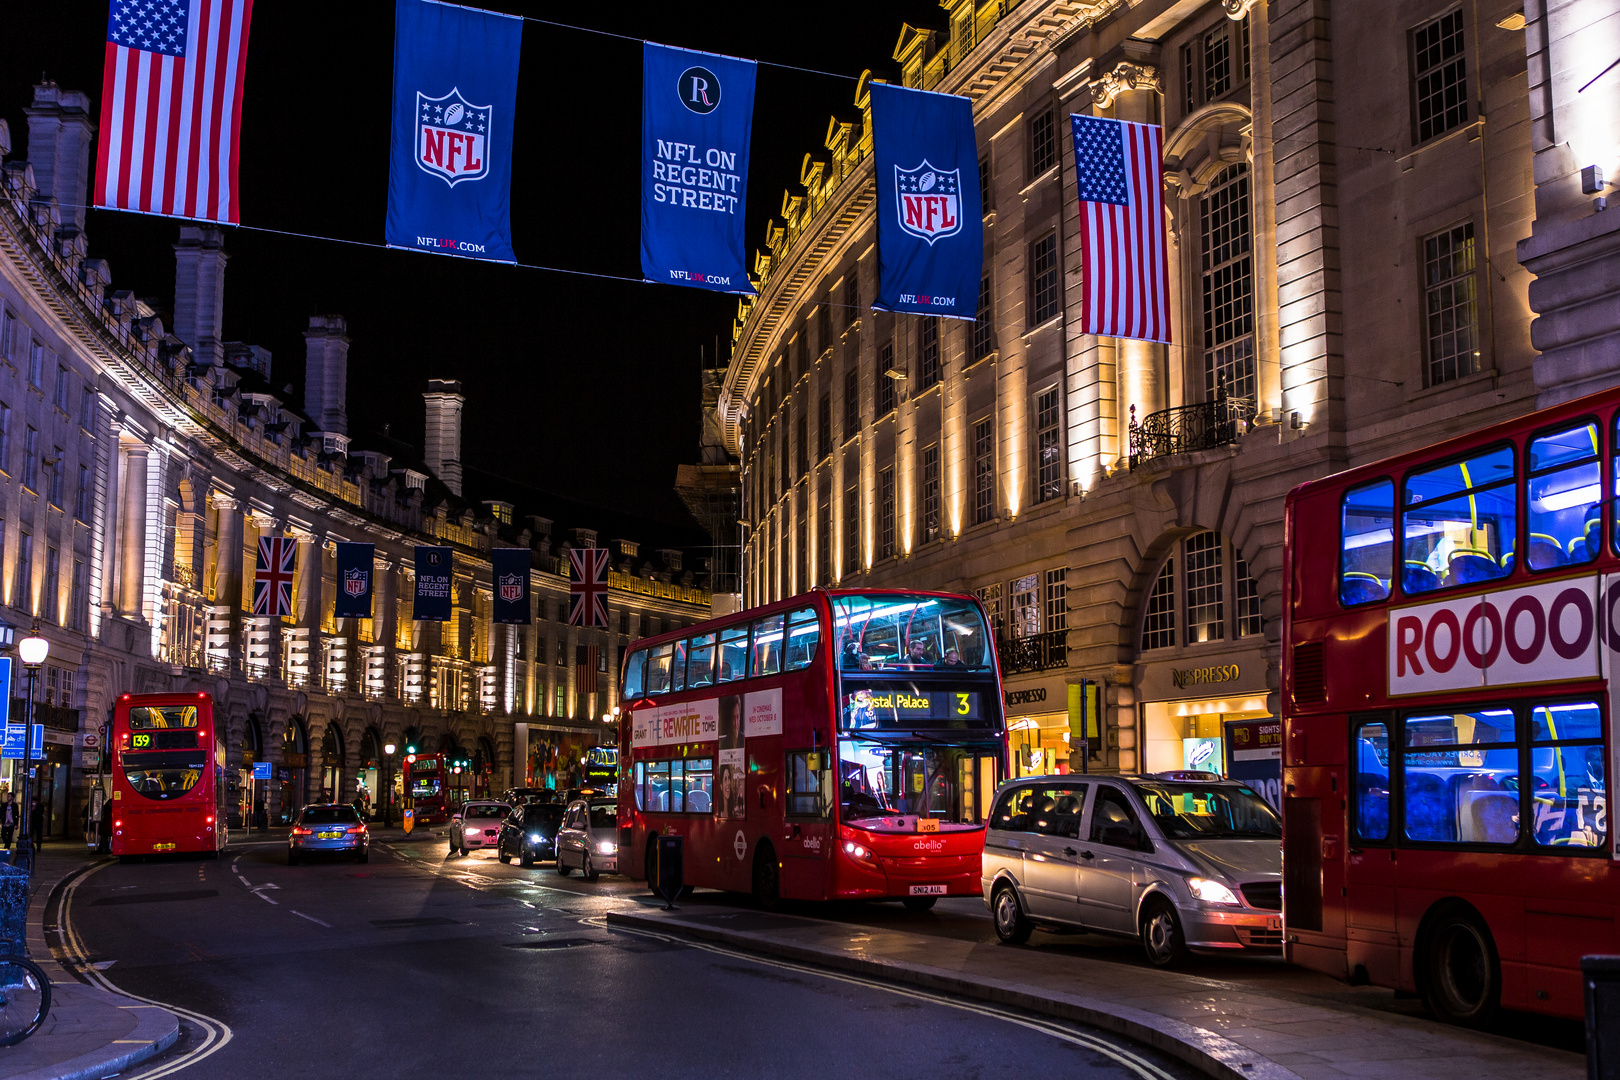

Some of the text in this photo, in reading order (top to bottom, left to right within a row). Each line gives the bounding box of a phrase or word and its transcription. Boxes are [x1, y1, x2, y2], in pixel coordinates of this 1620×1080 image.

[690, 76, 714, 106] R
[423, 127, 481, 174] NFL
[657, 139, 736, 170] NFL ON
[653, 159, 740, 193] REGENT
[654, 183, 738, 214] STREET
[904, 196, 955, 232] NFL
[417, 236, 485, 252] NFLUK.COM
[670, 270, 731, 285] NFLUK.COM
[899, 293, 956, 306] NFLUK.COM
[430, 553, 439, 563] R
[347, 580, 365, 592] NFL
[418, 582, 449, 591] REGENT
[420, 575, 436, 583] NFL
[418, 590, 449, 598] STREET
[502, 586, 521, 598] NFL
[1171, 664, 1240, 689] NESPRESSO
[855, 694, 893, 711] Crystal
[897, 694, 929, 708] Palace
[956, 693, 970, 714] 3
[1004, 687, 1047, 708] NESPRESSO
[648, 714, 700, 740] THE REWRITE
[702, 720, 716, 732] TOMEI
[133, 734, 150, 747] 139
[634, 729, 647, 740] GRANT
[913, 840, 942, 850] abellio
[913, 886, 942, 894] SN12 AUL
